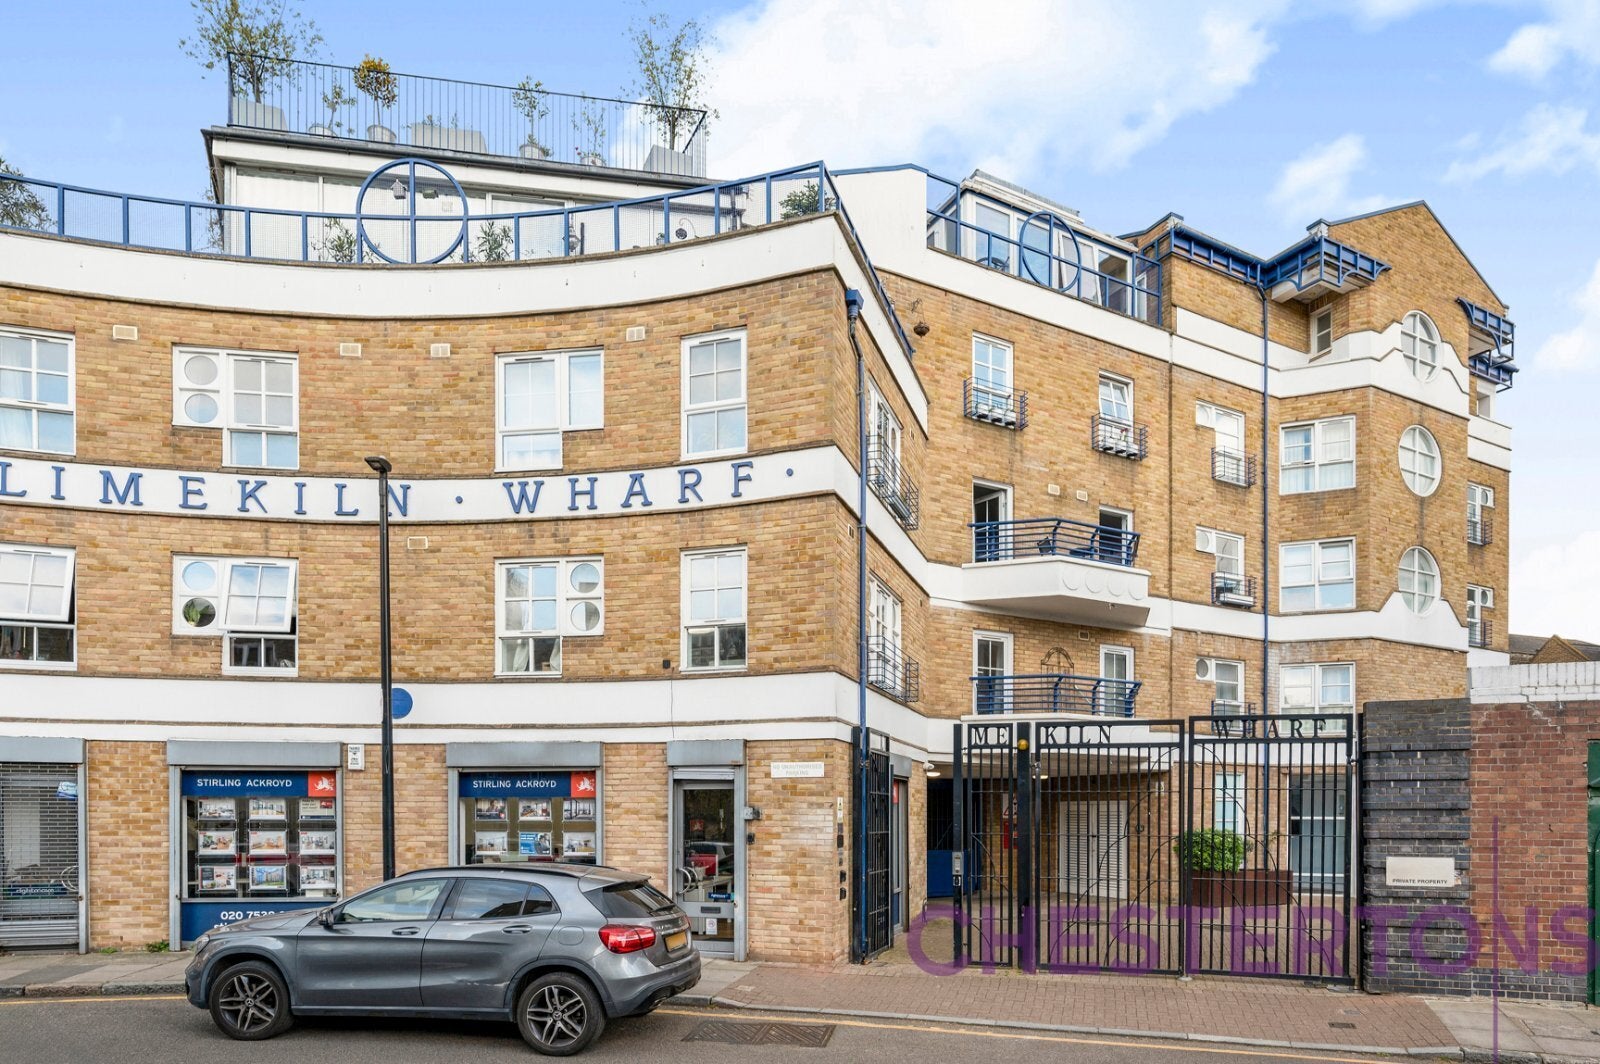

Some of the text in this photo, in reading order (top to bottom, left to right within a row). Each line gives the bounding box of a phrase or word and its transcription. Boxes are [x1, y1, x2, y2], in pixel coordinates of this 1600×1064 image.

[0, 461, 754, 517] LIMEKILN WHARF
[1214, 718, 1327, 739] WHARF
[197, 778, 293, 788] STIRLING ACKROYD
[472, 780, 558, 789] STIRLING ACKROYD
[220, 911, 244, 920] 020
